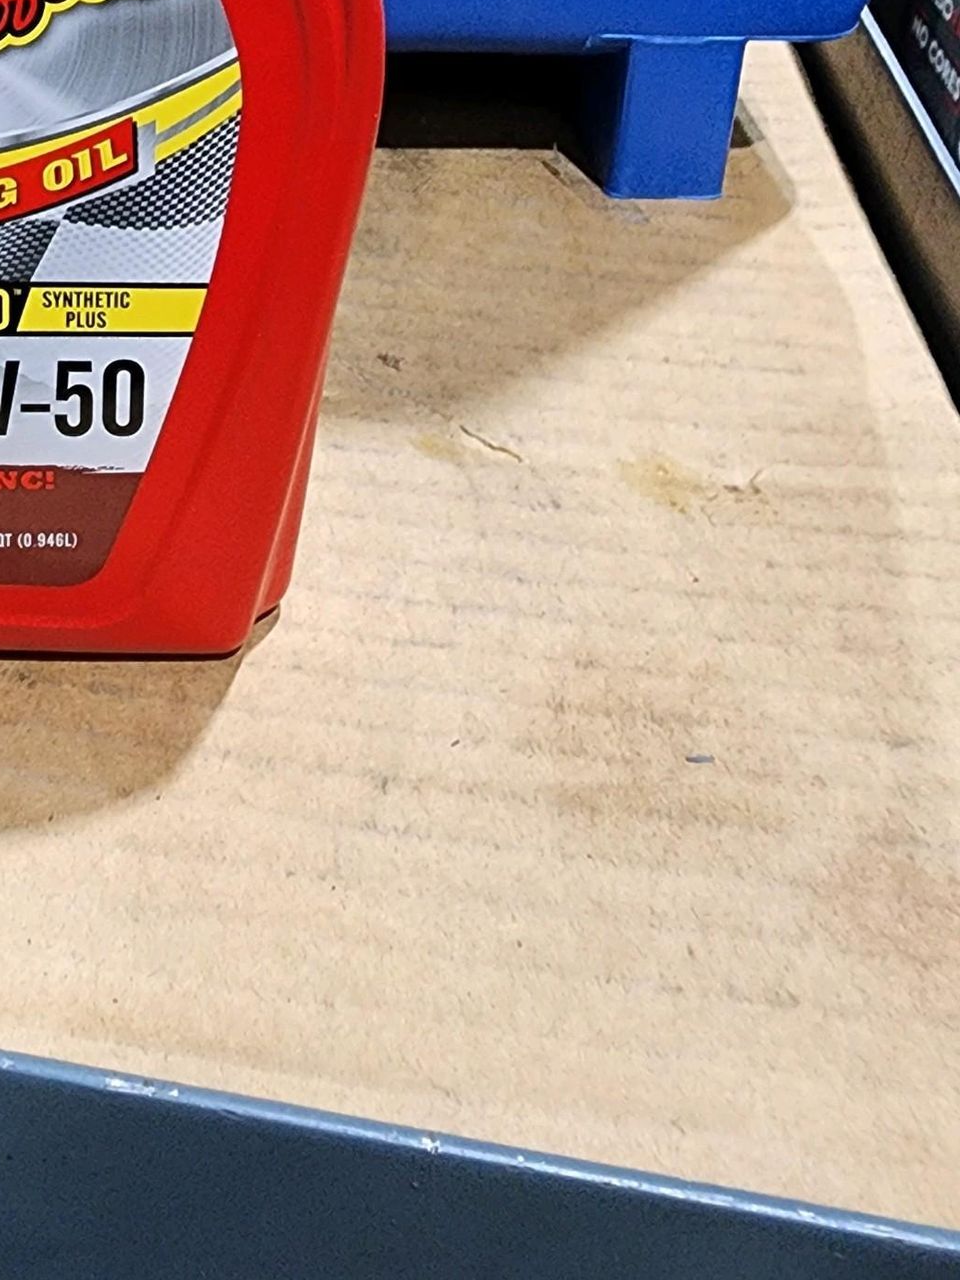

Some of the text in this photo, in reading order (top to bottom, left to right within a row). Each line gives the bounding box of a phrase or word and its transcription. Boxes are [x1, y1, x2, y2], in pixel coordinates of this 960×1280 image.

[42, 137, 129, 192] OIL
[42, 290, 131, 310] SYNTHETIC
[65, 311, 107, 329] PLUS
[17, 532, 78, 549] (0.946L)
